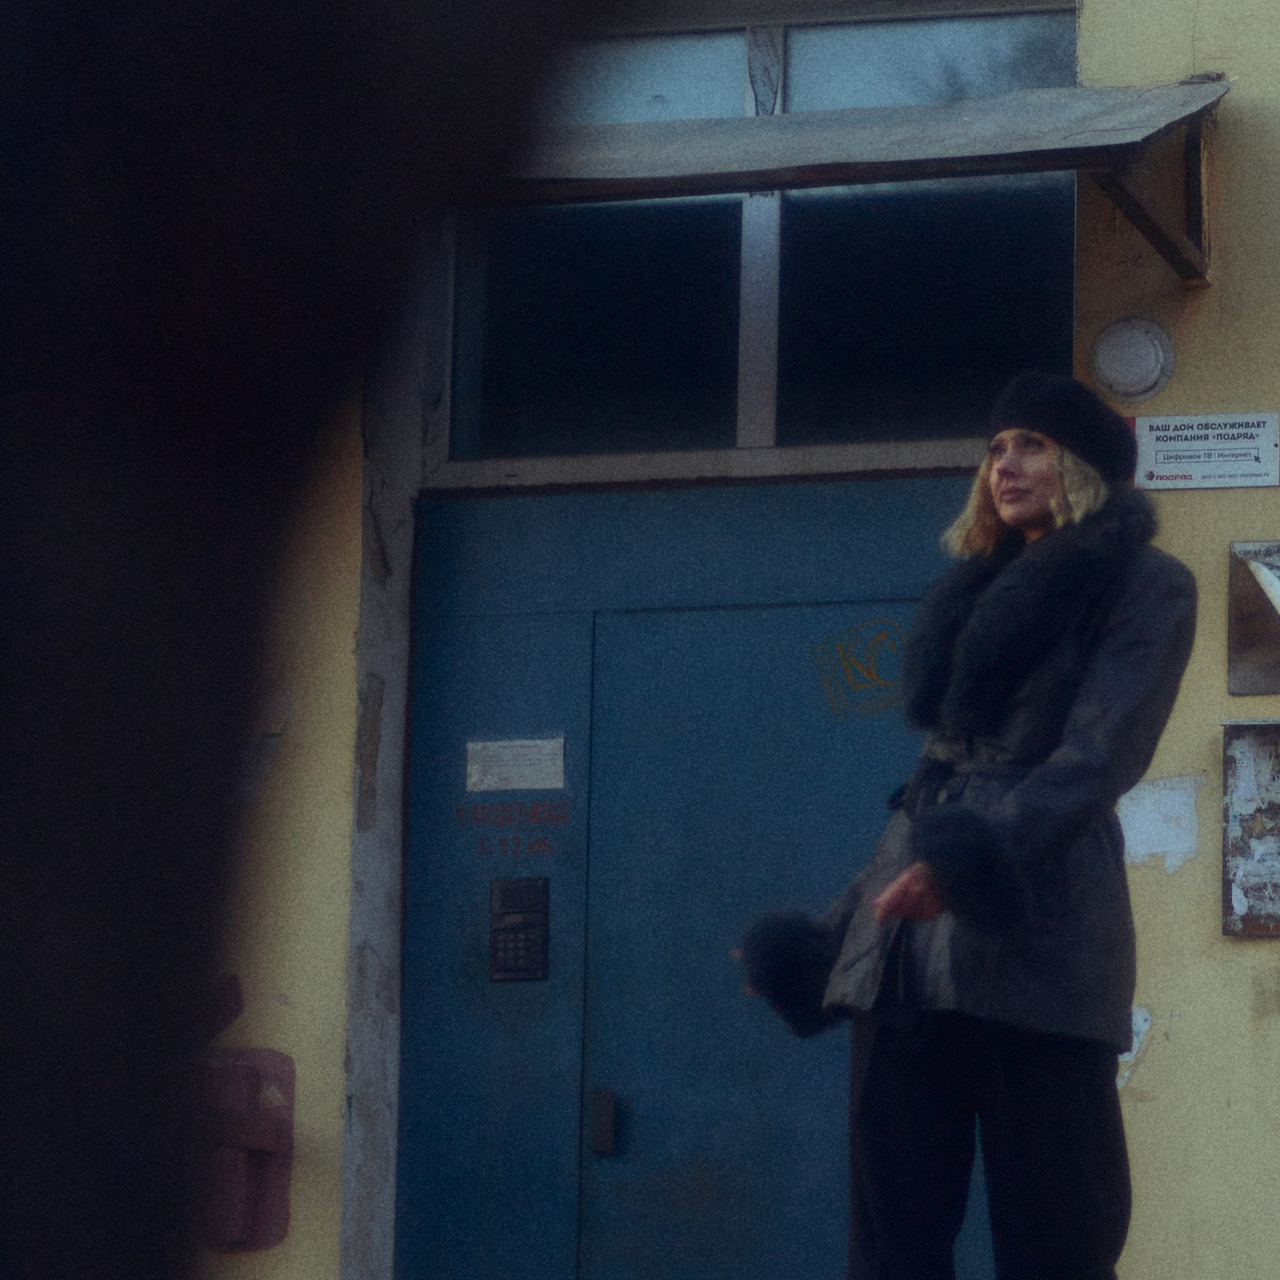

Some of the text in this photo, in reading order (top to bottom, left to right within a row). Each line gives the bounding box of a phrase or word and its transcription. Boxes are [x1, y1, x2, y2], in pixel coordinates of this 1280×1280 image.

[1149, 421, 1267, 432] ВАШ ДОМ ОБСЛУЖИВАЕТ
[1155, 433, 1209, 442] КОМПАНИЯ
[1163, 452, 1201, 461] Цифровое
[1217, 451, 1252, 459] Интернет
